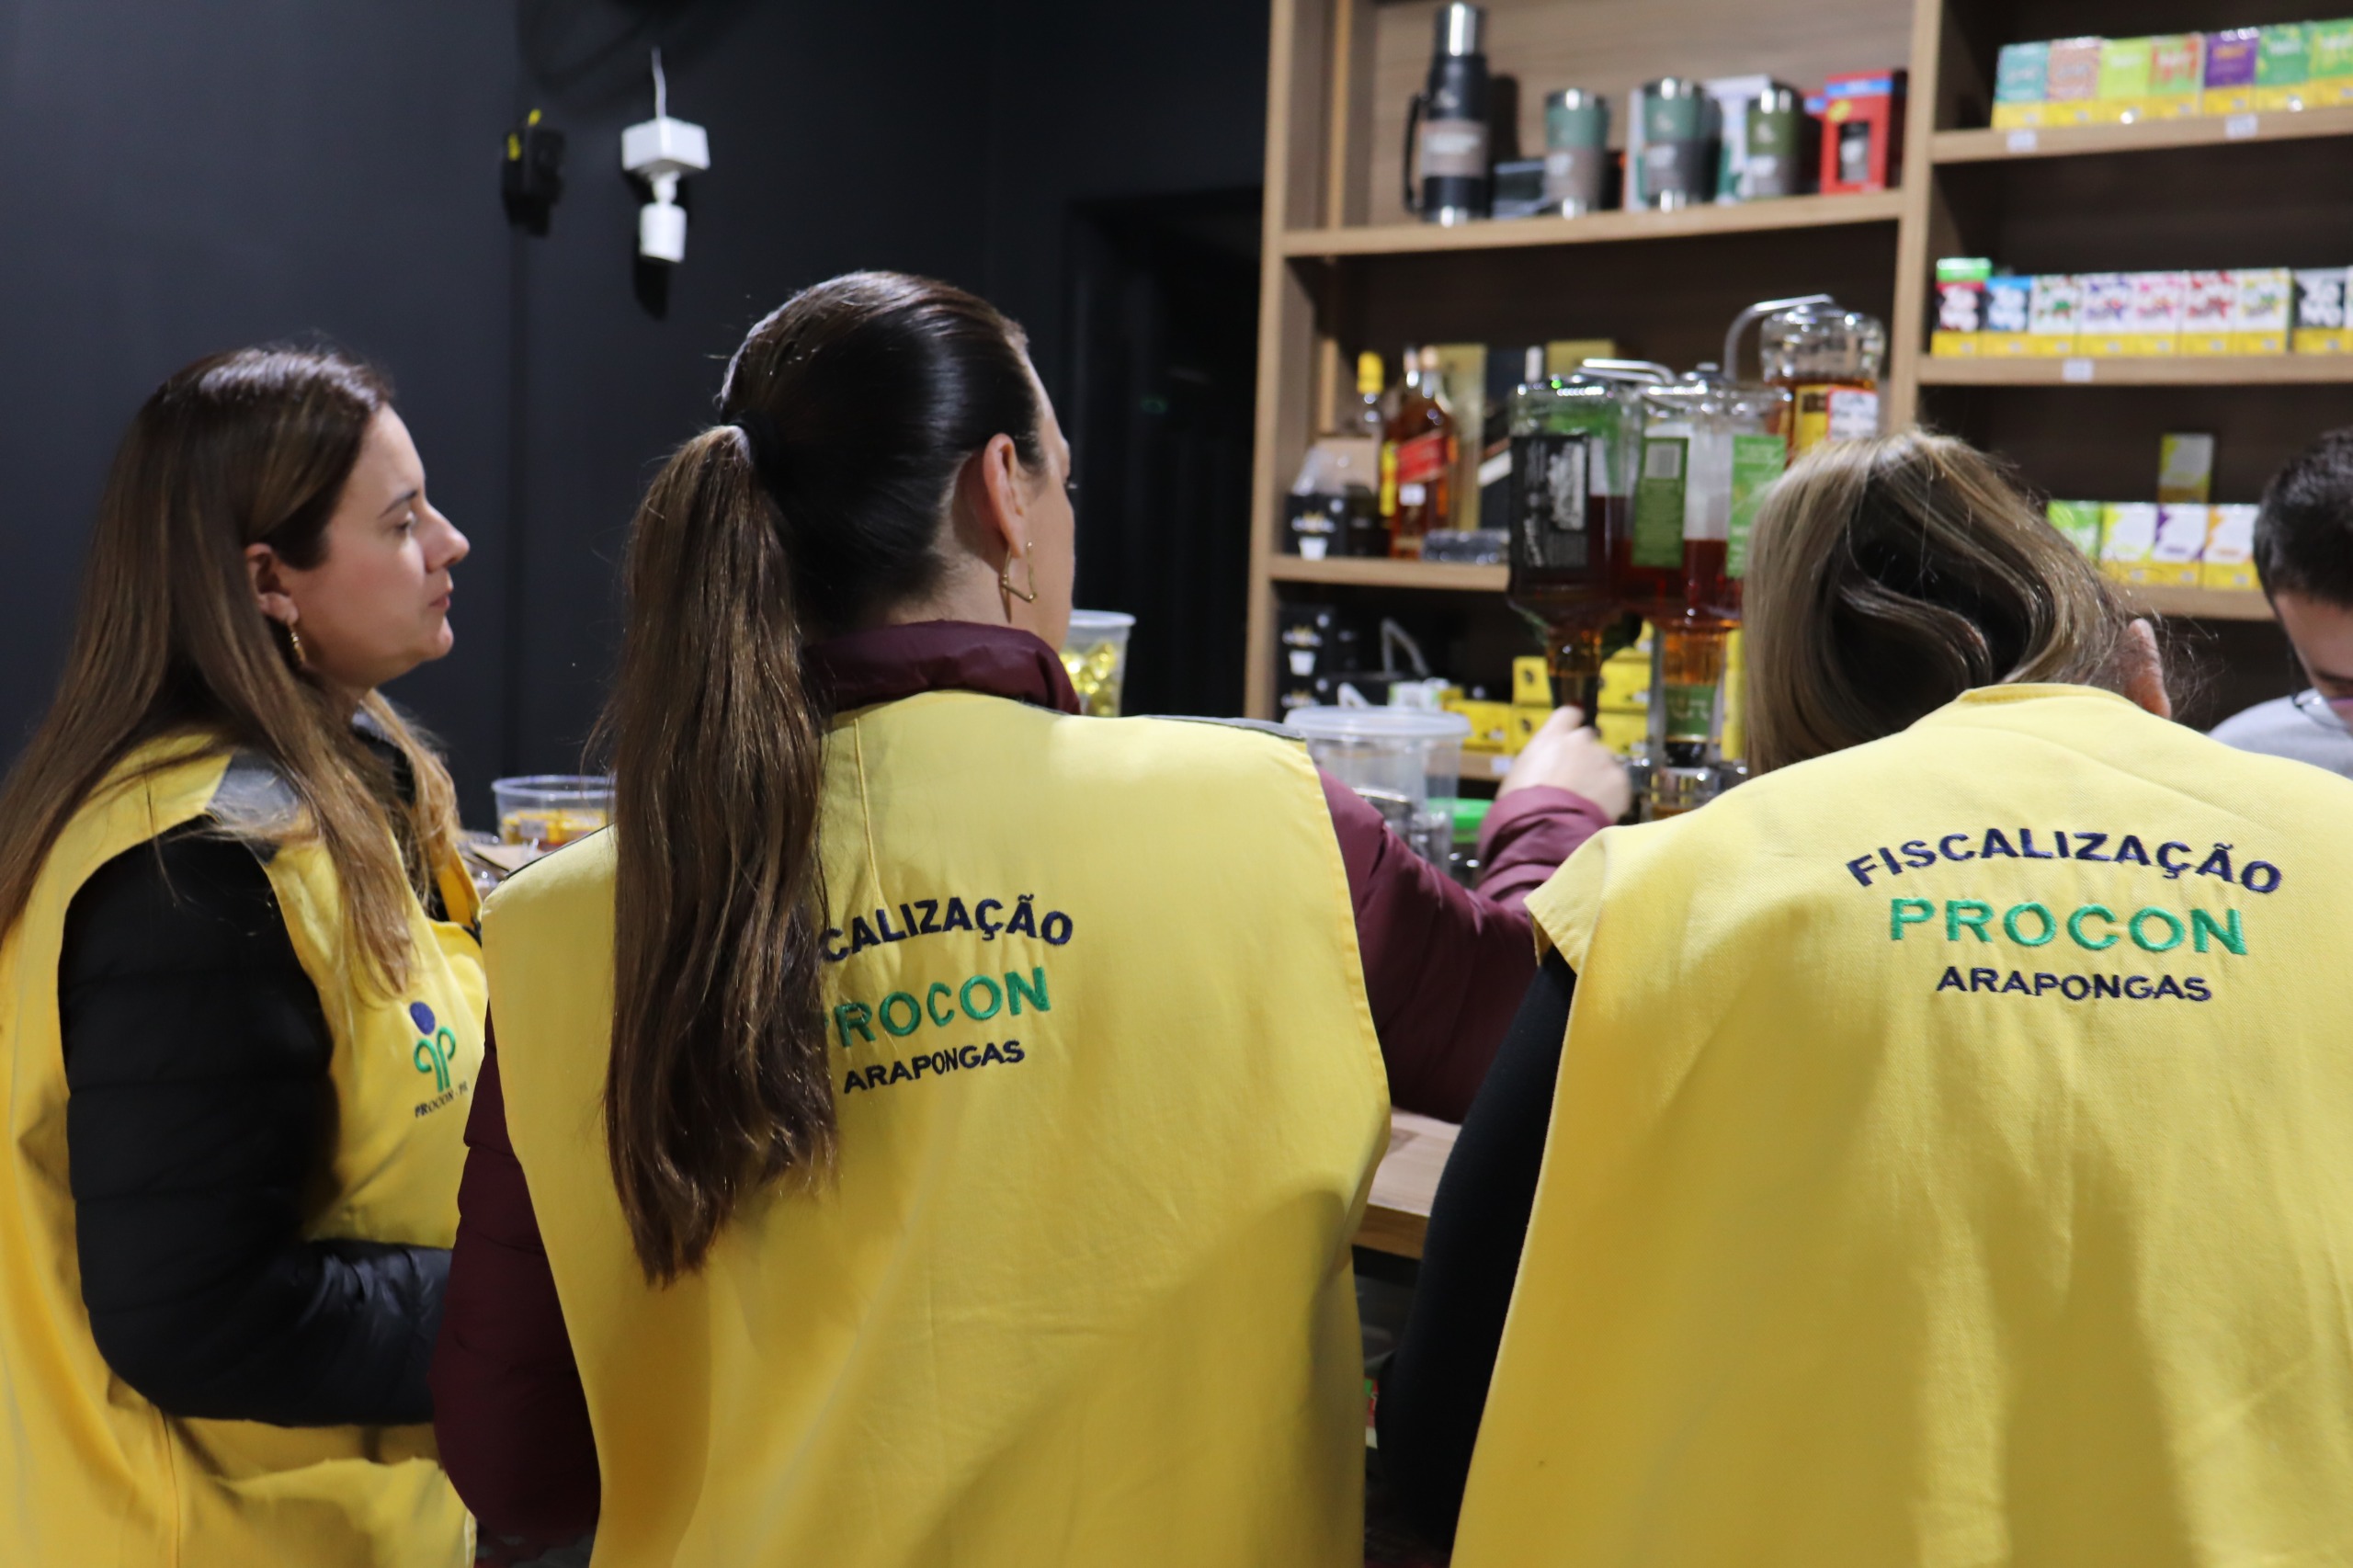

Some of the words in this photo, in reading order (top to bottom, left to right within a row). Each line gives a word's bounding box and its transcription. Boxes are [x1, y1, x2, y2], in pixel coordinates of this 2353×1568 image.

[1846, 827, 2282, 893] FISCALIZAÇÃO
[822, 893, 1074, 962] CALIZAÇÃO
[1890, 898, 2248, 955] PROCON
[824, 966, 1051, 1048] ROCON
[1936, 966, 2212, 1002] ARAPONGAS
[843, 1040, 1025, 1094] ARAPONGAS
